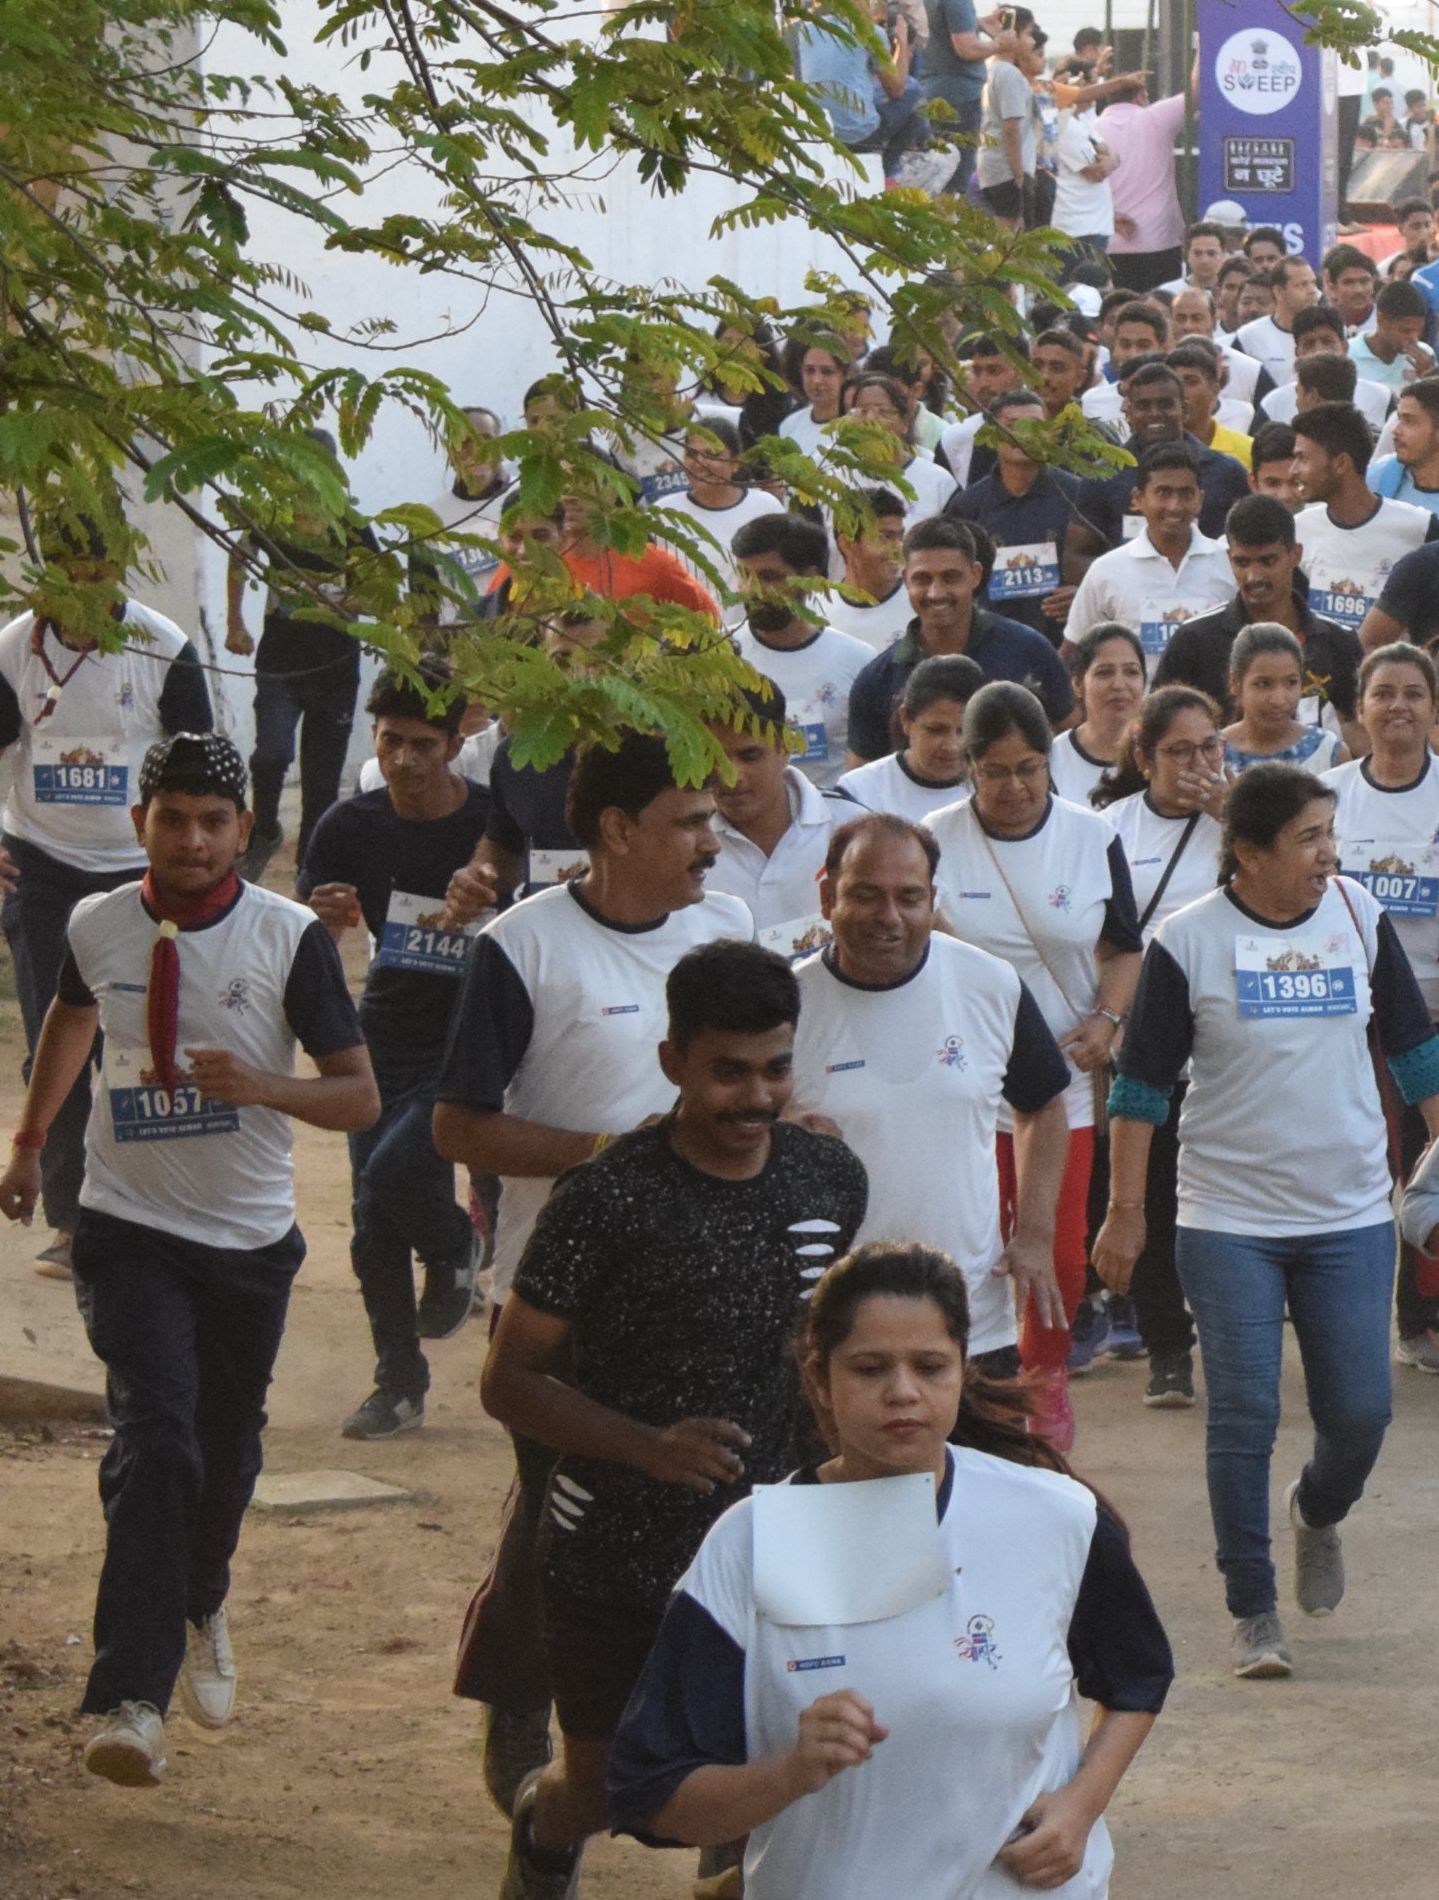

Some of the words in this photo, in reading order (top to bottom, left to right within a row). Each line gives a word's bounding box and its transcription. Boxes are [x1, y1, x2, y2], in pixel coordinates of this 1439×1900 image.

[1224, 75, 1296, 92] SWEEP
[656, 471, 691, 490] 2345
[1004, 568, 1044, 587] 2113
[1326, 594, 1366, 616] 1696
[56, 767, 105, 788] 1681
[1363, 876, 1417, 900] 1007
[407, 930, 466, 958] 2144
[1262, 973, 1328, 999] 1396
[138, 1087, 201, 1118] 1057
